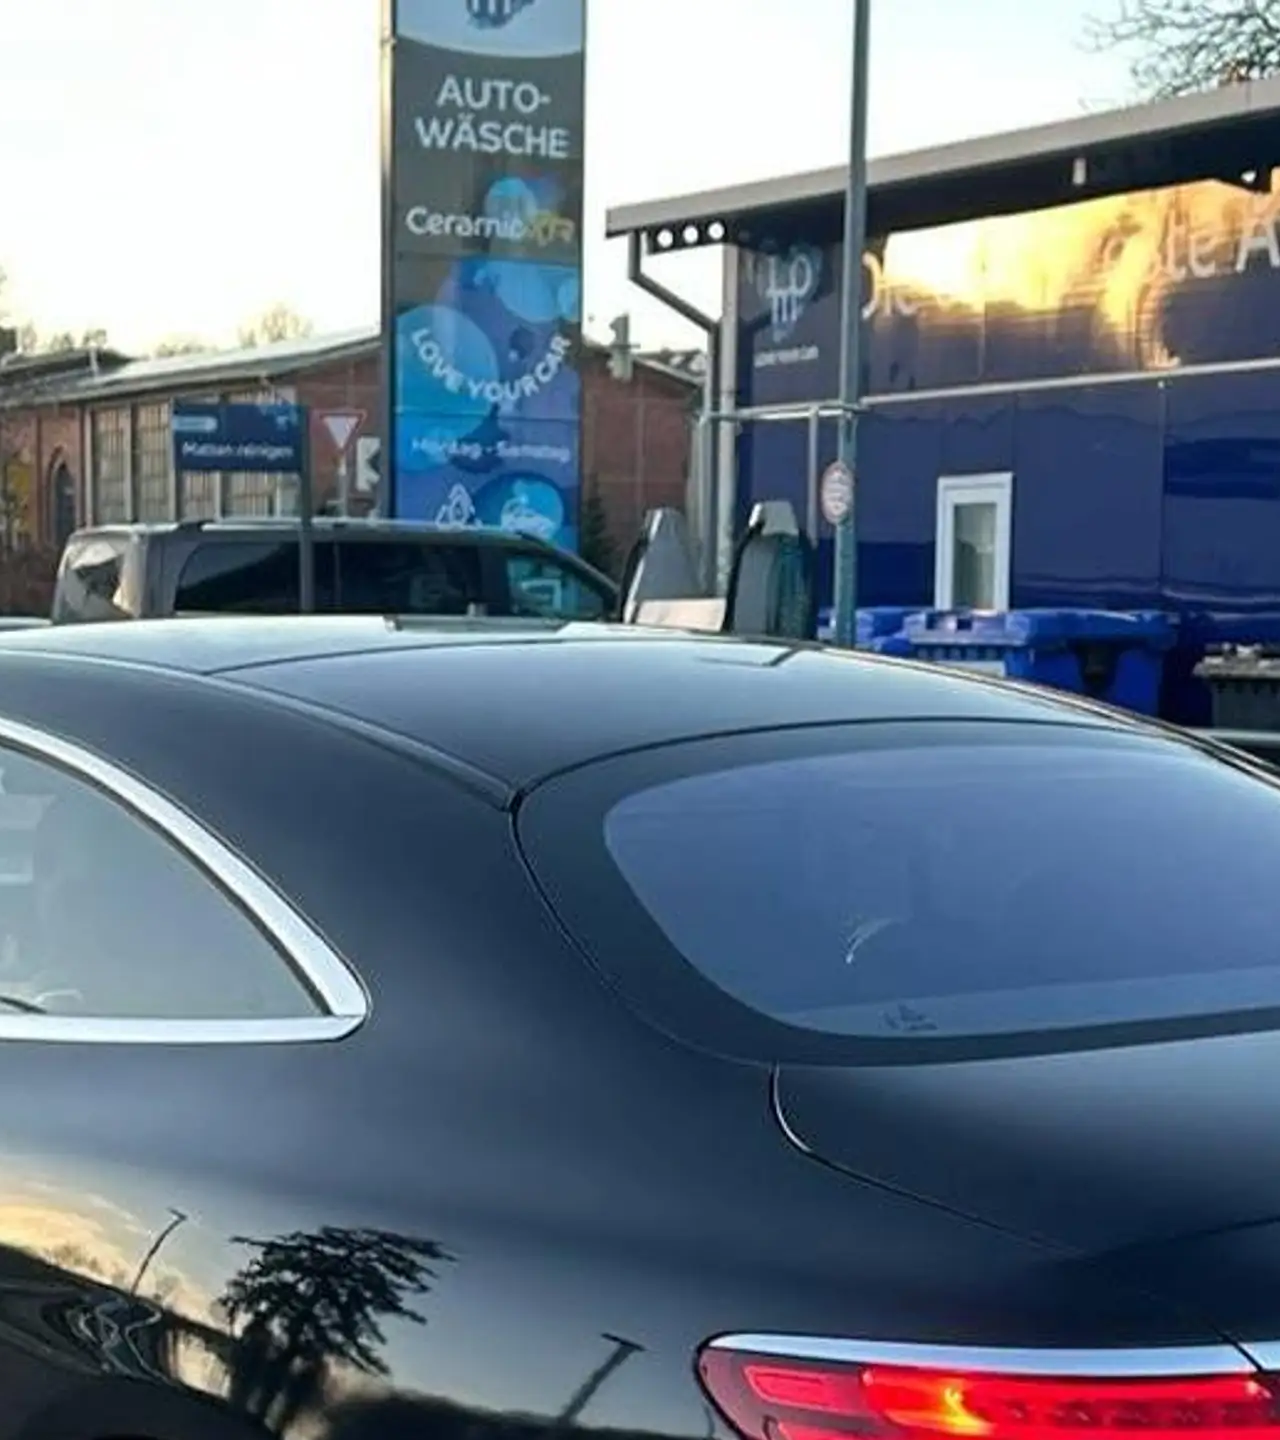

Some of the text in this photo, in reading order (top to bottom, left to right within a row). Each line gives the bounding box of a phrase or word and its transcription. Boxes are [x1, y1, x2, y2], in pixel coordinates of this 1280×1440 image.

[437, 74, 552, 114] AUTO-
[414, 112, 571, 159] WÄSCHE
[405, 204, 527, 241] Ceramic
[468, 374, 540, 402] YOUR
[534, 335, 572, 383] CAR
